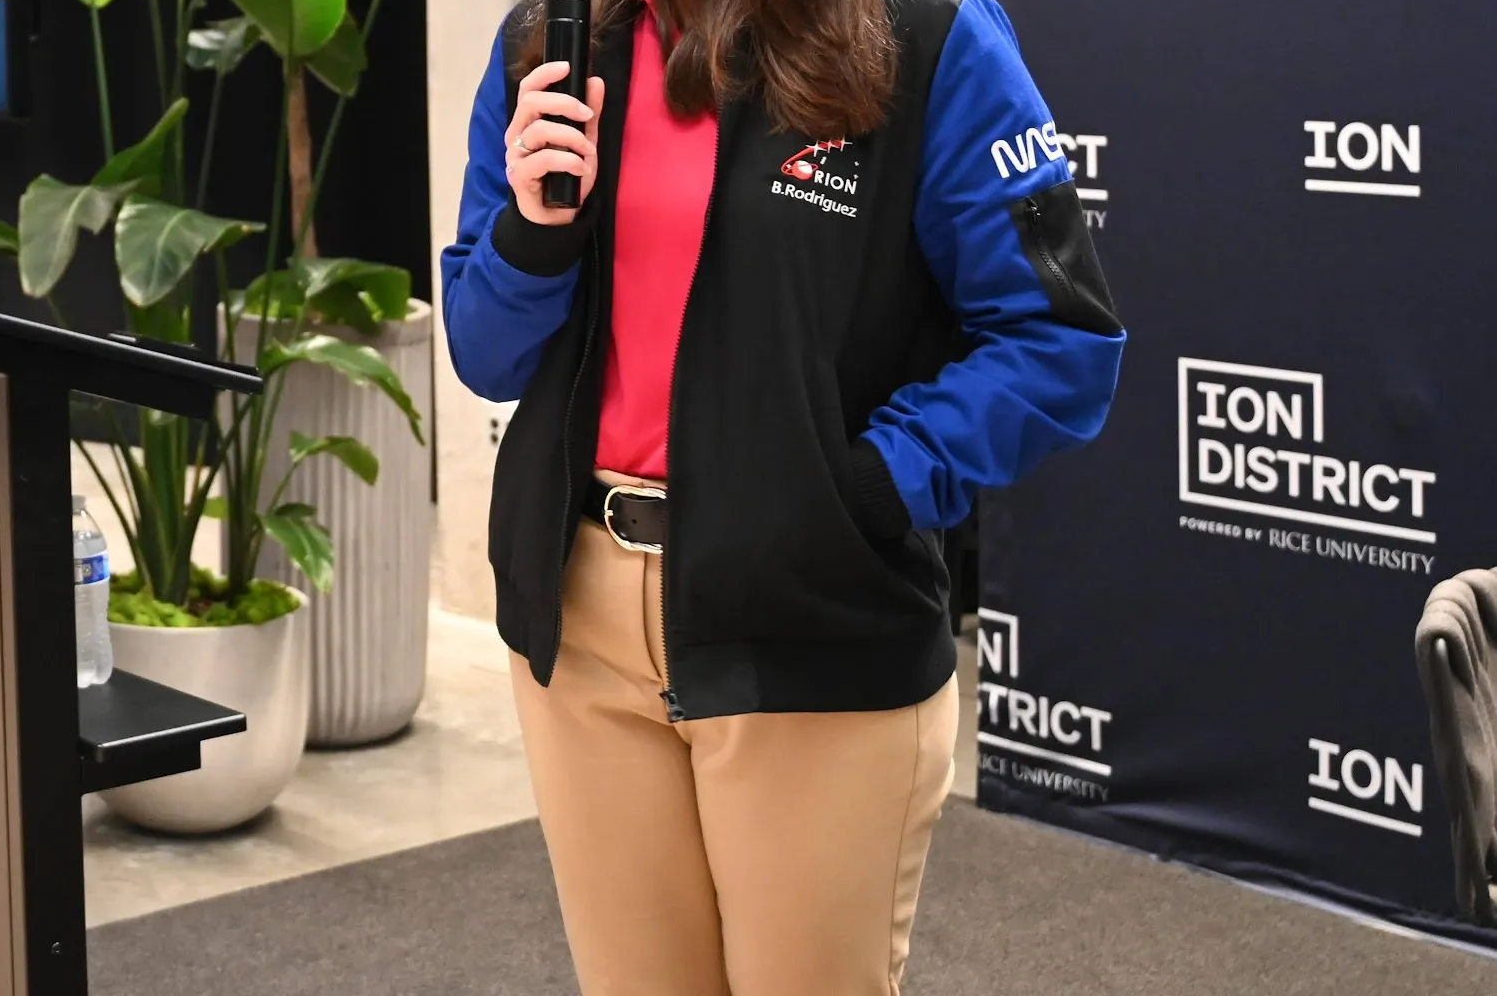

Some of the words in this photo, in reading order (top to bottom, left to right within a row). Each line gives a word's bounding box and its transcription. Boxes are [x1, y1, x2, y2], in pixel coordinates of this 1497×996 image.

[1303, 120, 1421, 174] ION
[770, 180, 858, 218] B.Rodriguez
[1197, 381, 1302, 441] ION
[1198, 437, 1436, 518] DISTRICT
[1178, 515, 1242, 539] POWERED
[1244, 527, 1263, 541] BY
[1268, 527, 1311, 554] RICE
[1315, 535, 1435, 575] UNIVERSITY
[976, 680, 1113, 753] TRICT
[1011, 760, 1110, 802] UNIVERSITY
[1308, 738, 1424, 813] ION
